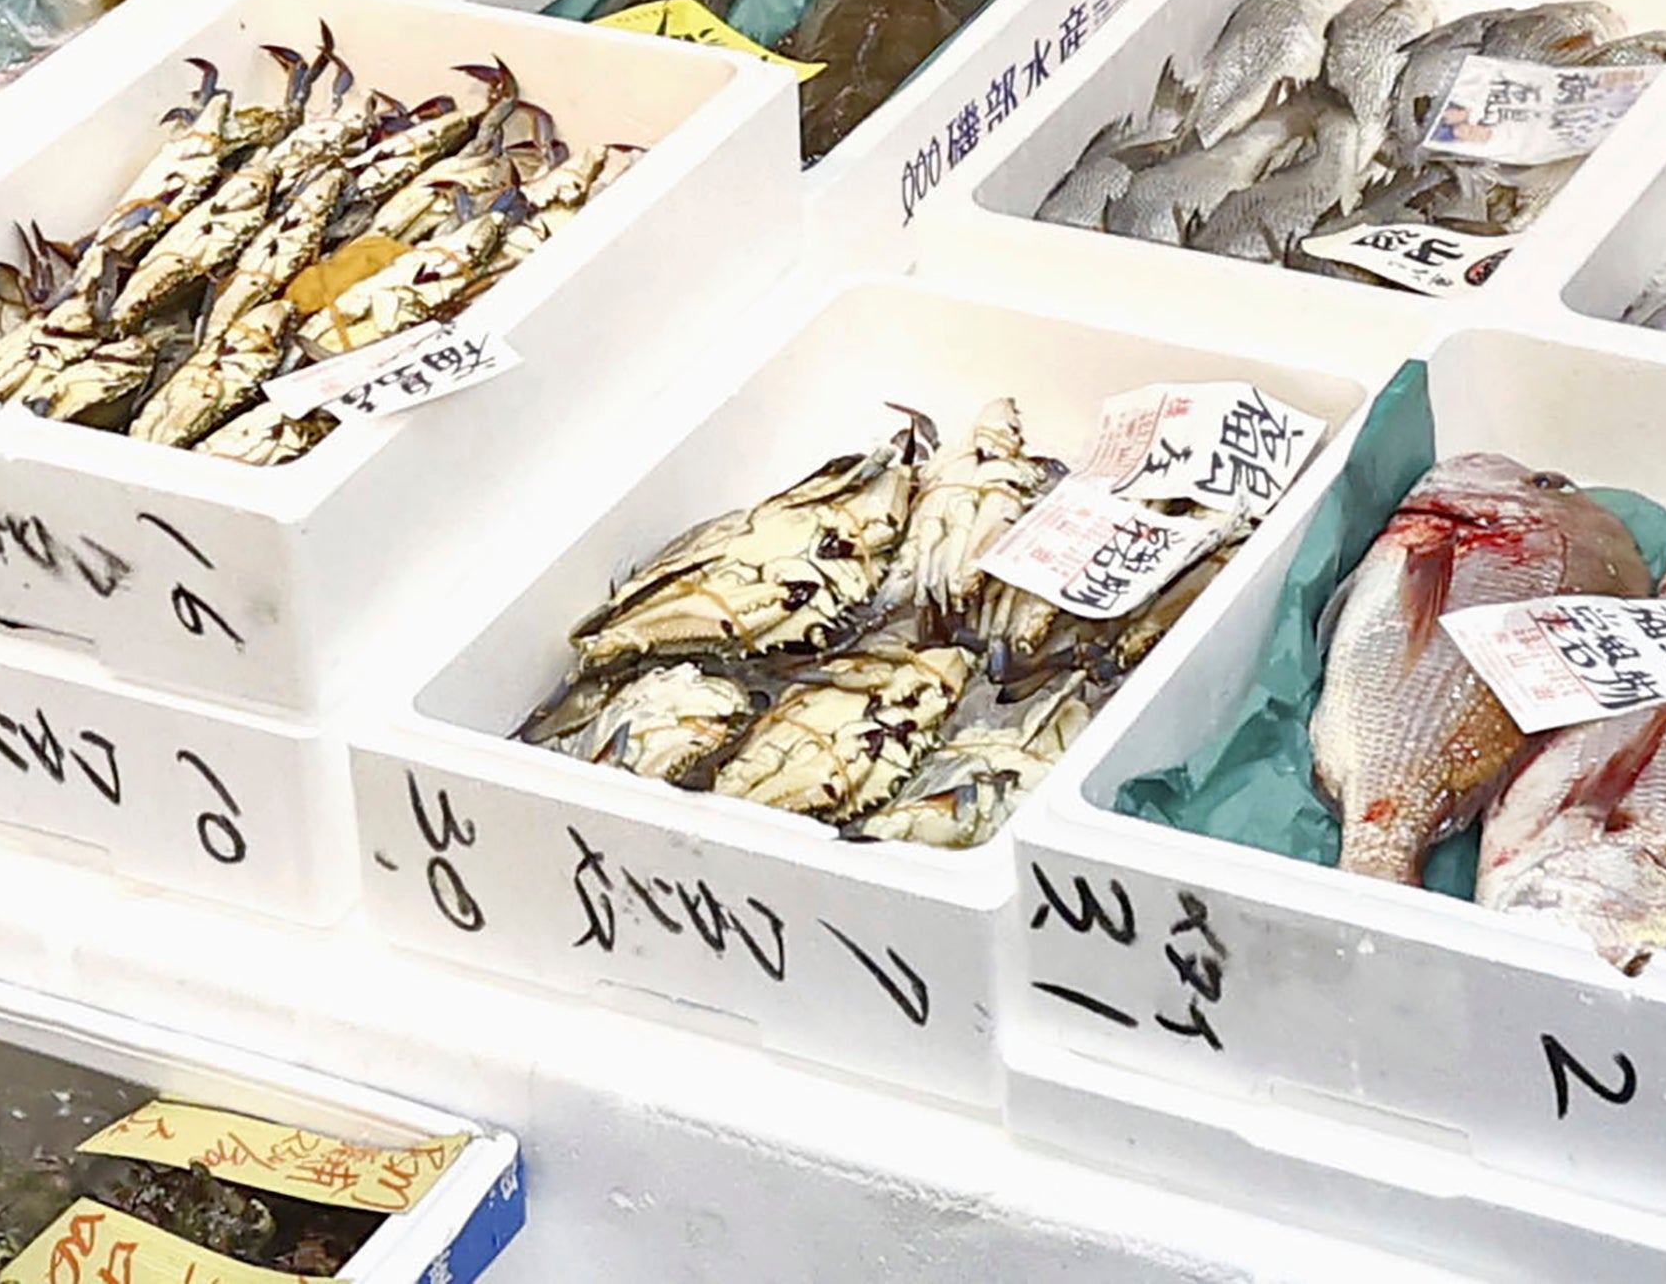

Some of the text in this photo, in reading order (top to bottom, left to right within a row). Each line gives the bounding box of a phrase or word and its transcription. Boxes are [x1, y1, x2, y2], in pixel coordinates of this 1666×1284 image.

[945, 2, 1089, 173] 磯部水産
[1111, 386, 1301, 503] 福島産
[177, 748, 247, 866] 10
[618, 867, 788, 983] ワタリ
[1030, 861, 1138, 1031] 3.1
[1538, 1032, 1638, 1122] 2
